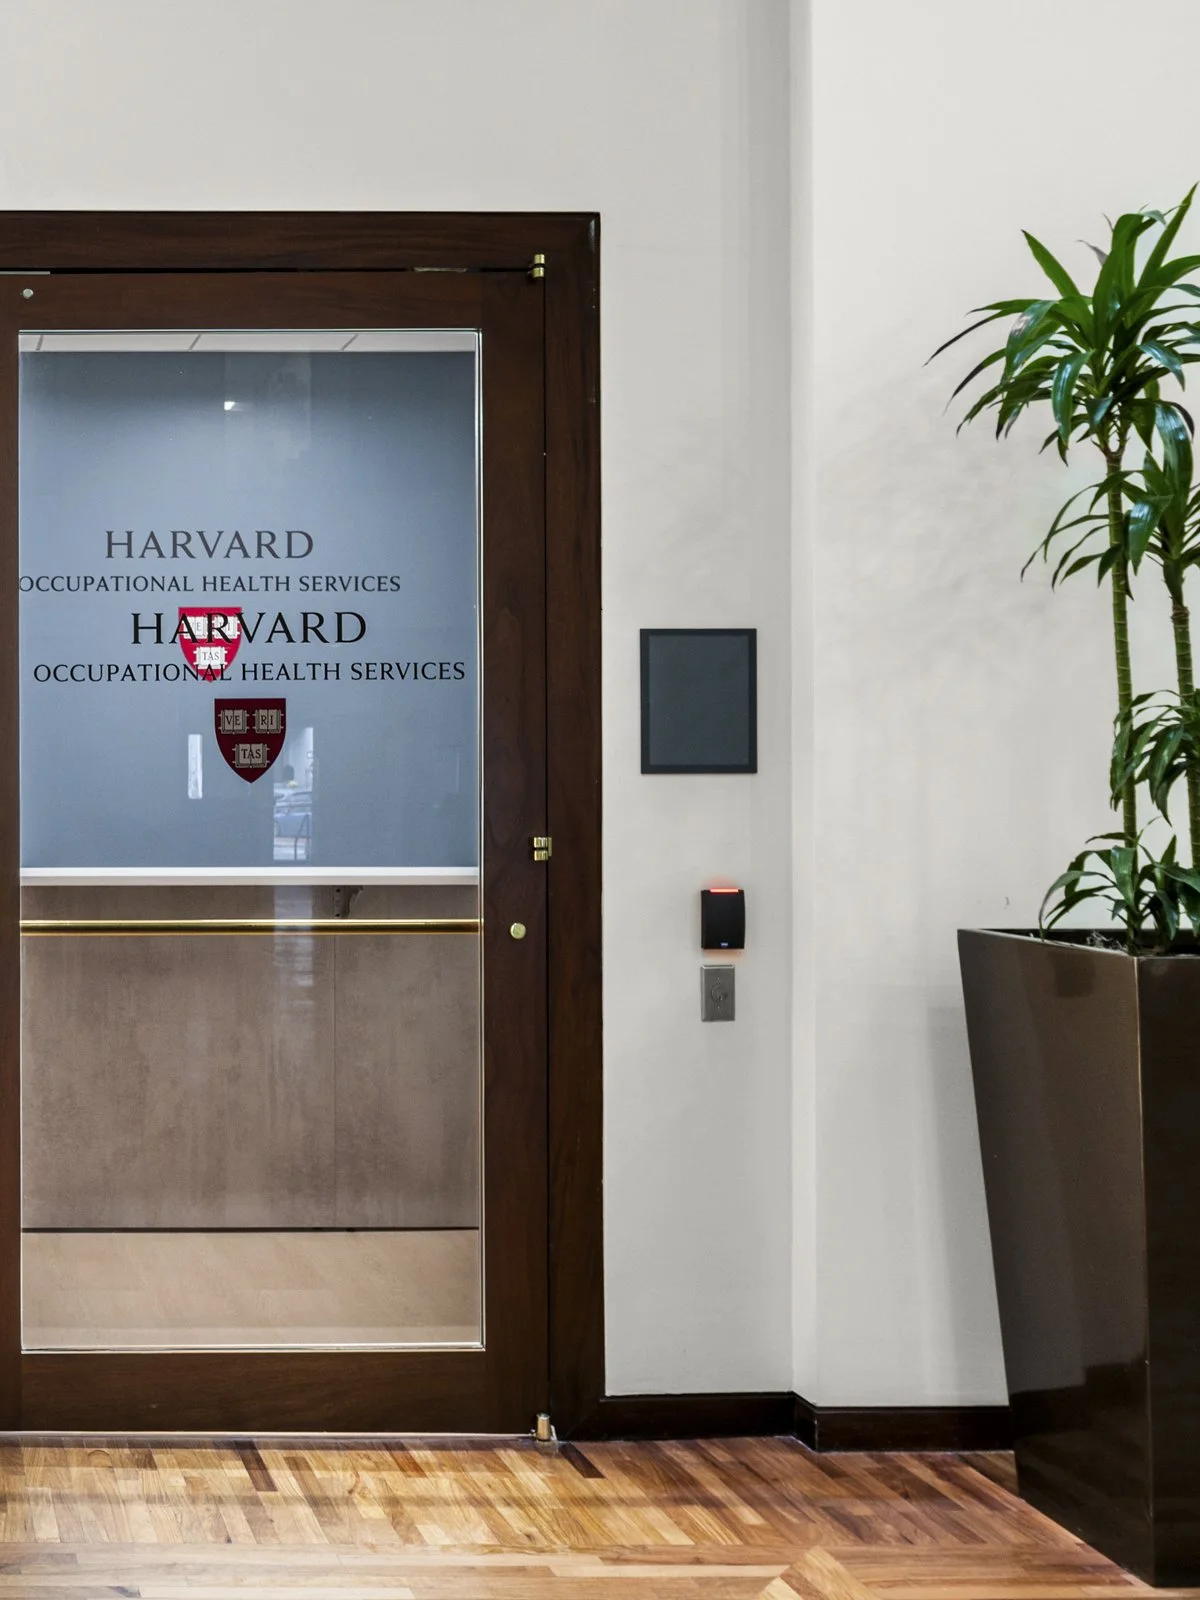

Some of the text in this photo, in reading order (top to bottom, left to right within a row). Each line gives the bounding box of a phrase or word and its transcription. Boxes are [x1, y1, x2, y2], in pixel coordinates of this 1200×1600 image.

[105, 530, 314, 559] HARVARD
[19, 575, 401, 592] OCCUPATIONAL HEALTH SERVICES
[131, 612, 366, 644] HARVARD
[202, 651, 220, 661] TAS
[33, 661, 465, 682] OCCUPATIONAL HEALTH SERVICES
[225, 715, 274, 726] VE RI
[241, 748, 262, 759] TAS
